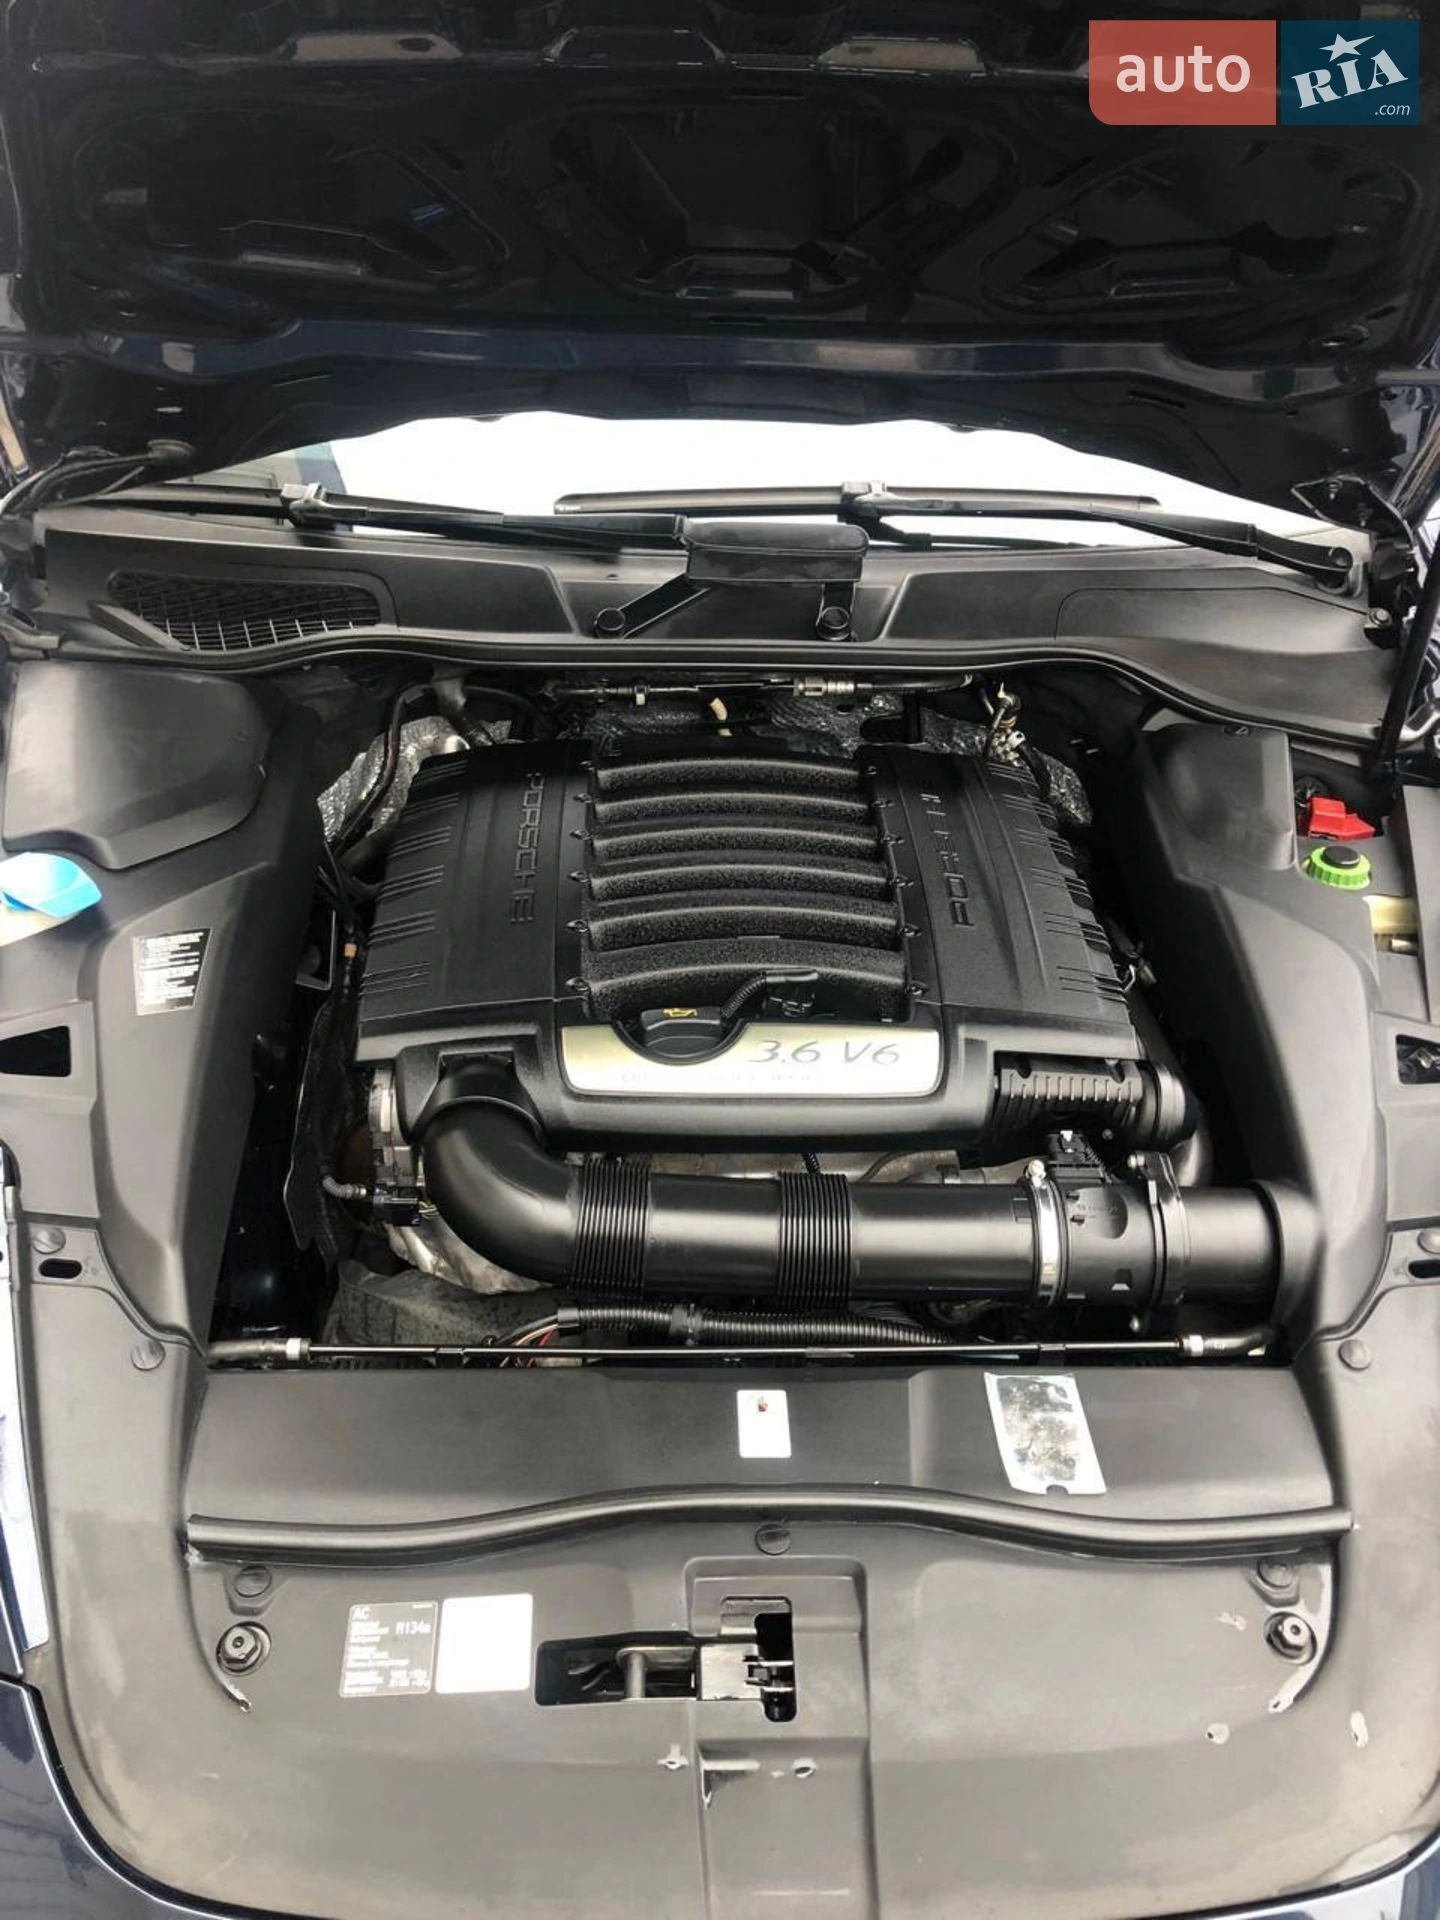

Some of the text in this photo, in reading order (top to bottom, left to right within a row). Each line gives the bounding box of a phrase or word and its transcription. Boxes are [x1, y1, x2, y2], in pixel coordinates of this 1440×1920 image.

[509, 772, 545, 925] PORSCHE
[748, 1040, 902, 1065] 3.6 V6
[352, 1607, 371, 1620] AC
